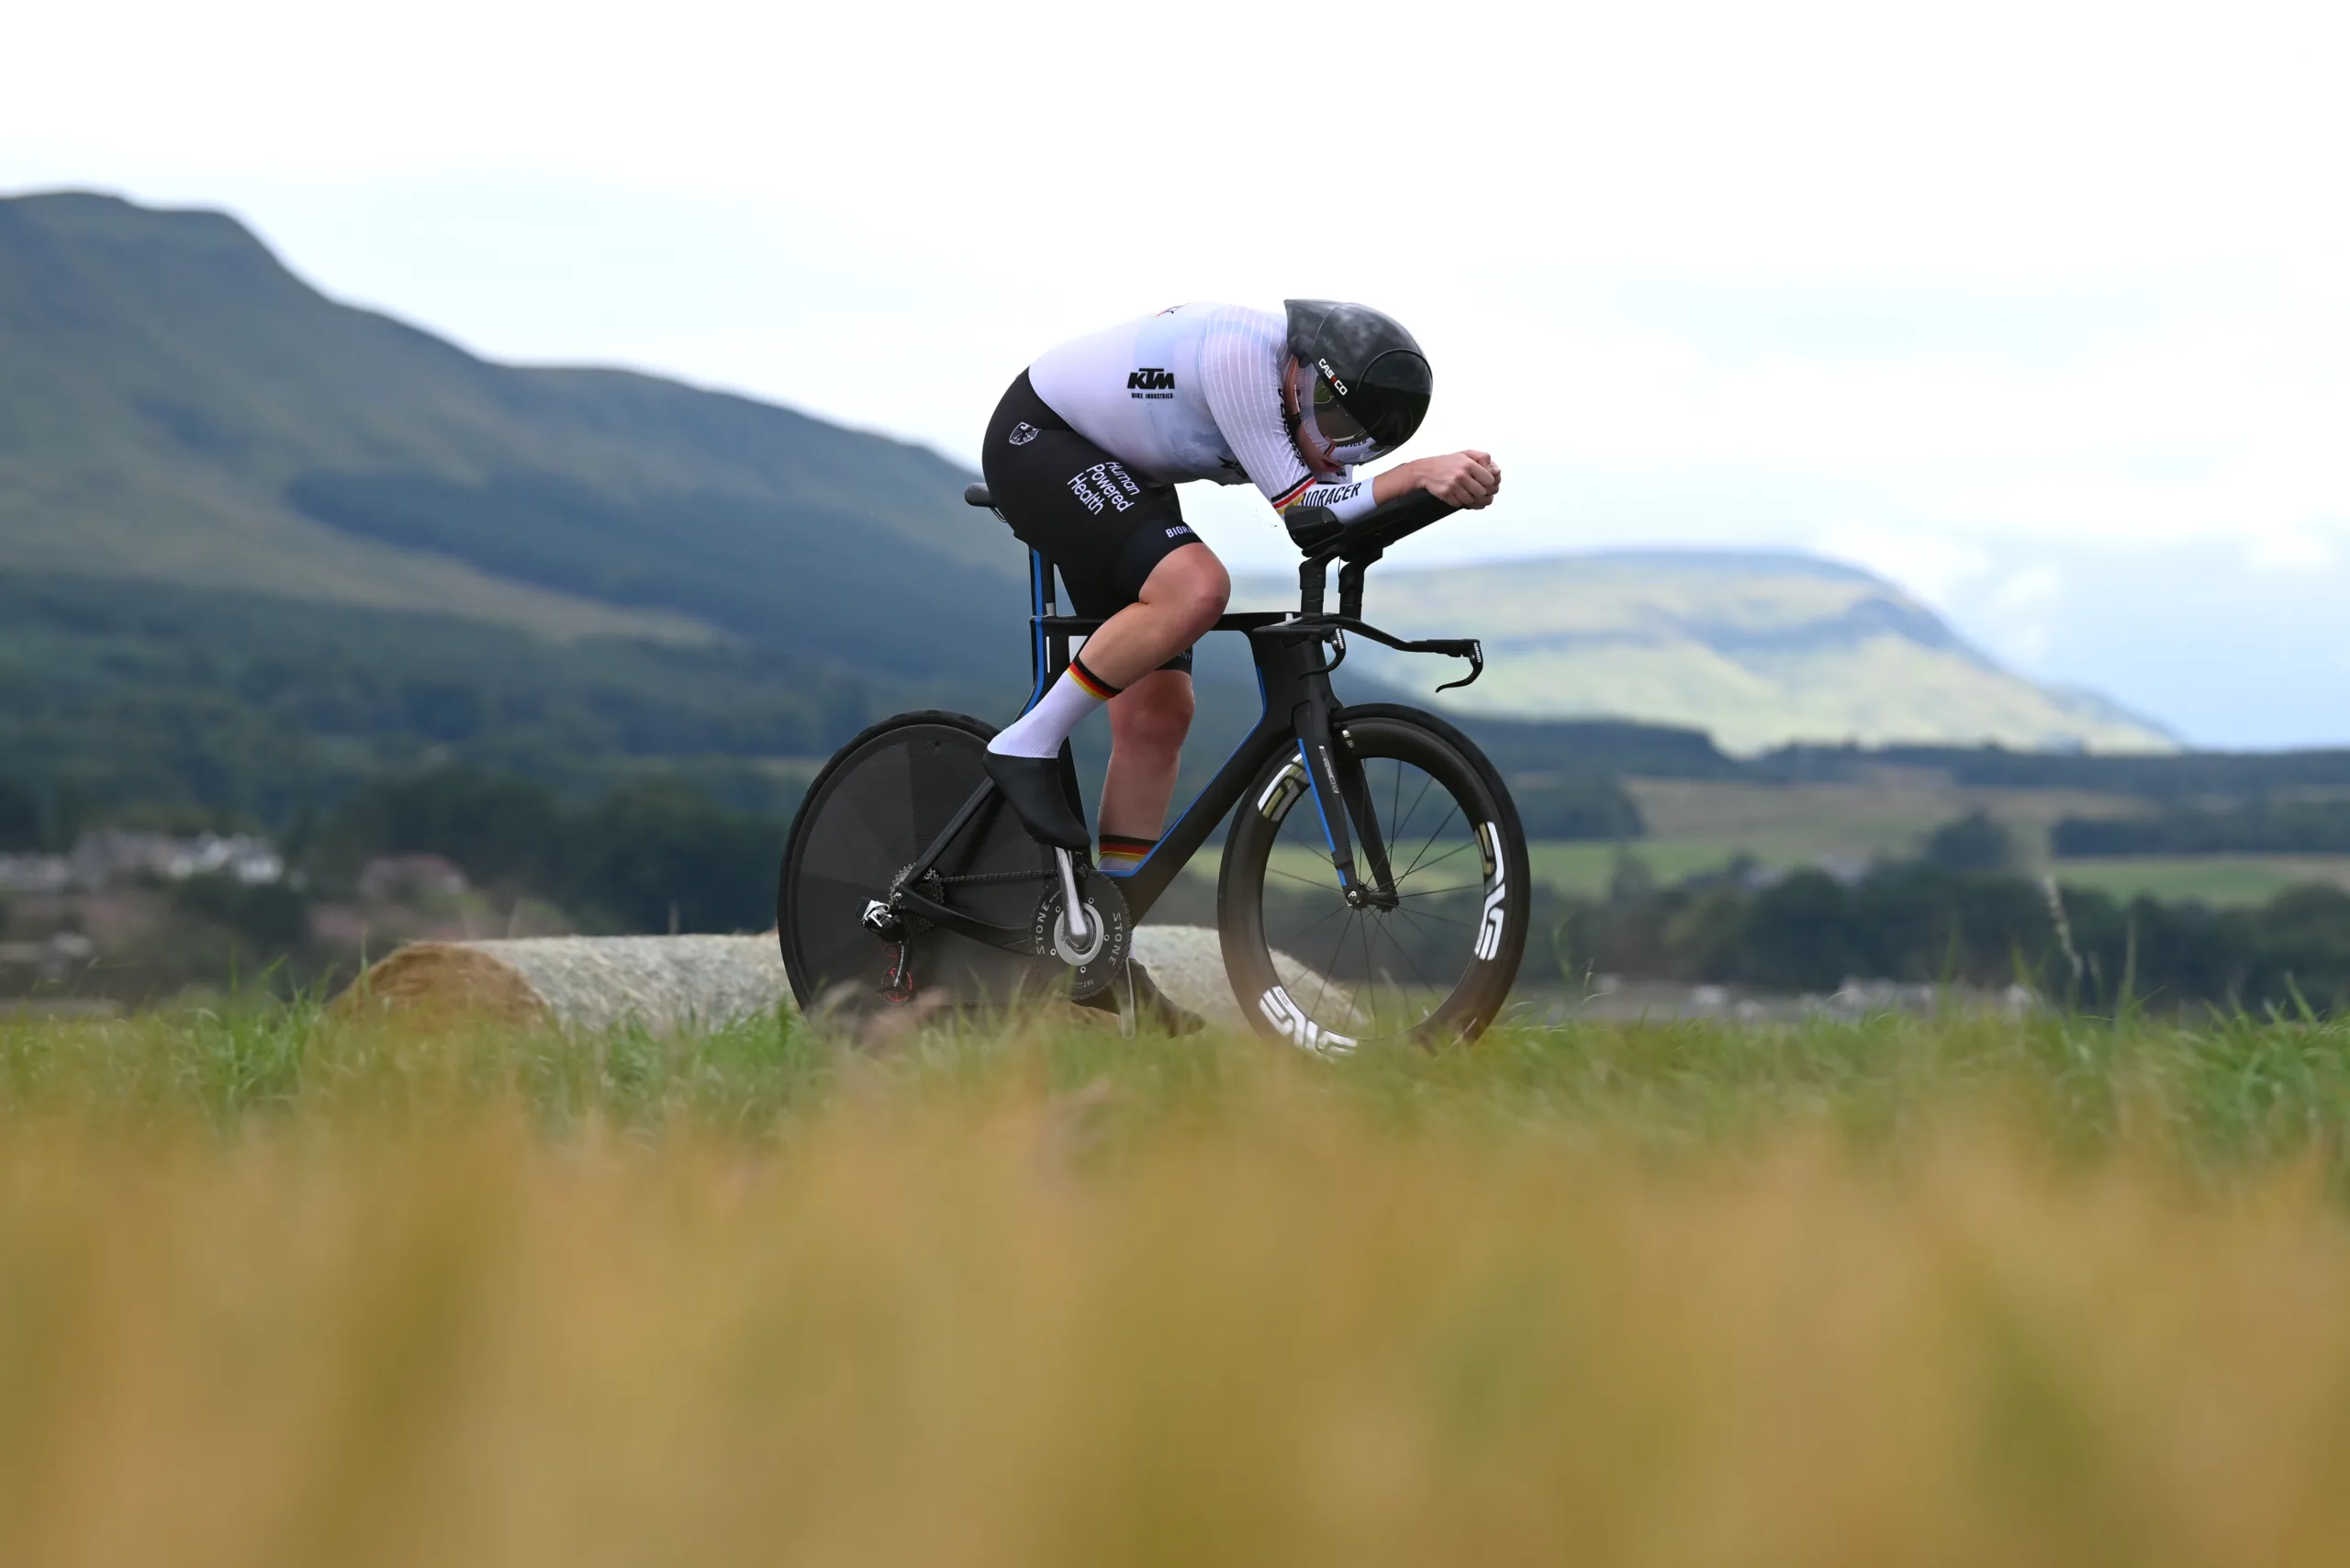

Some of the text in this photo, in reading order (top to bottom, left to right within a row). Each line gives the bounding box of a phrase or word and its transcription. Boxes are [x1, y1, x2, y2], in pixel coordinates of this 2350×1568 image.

[1126, 367, 1176, 390] KTM
[1145, 392, 1174, 400] INDUSTRIES
[1067, 472, 1105, 515] Health
[1086, 463, 1135, 512] Powered
[1105, 461, 1140, 496] Human
[1035, 901, 1051, 956] STONE
[1107, 912, 1124, 966] STONE
